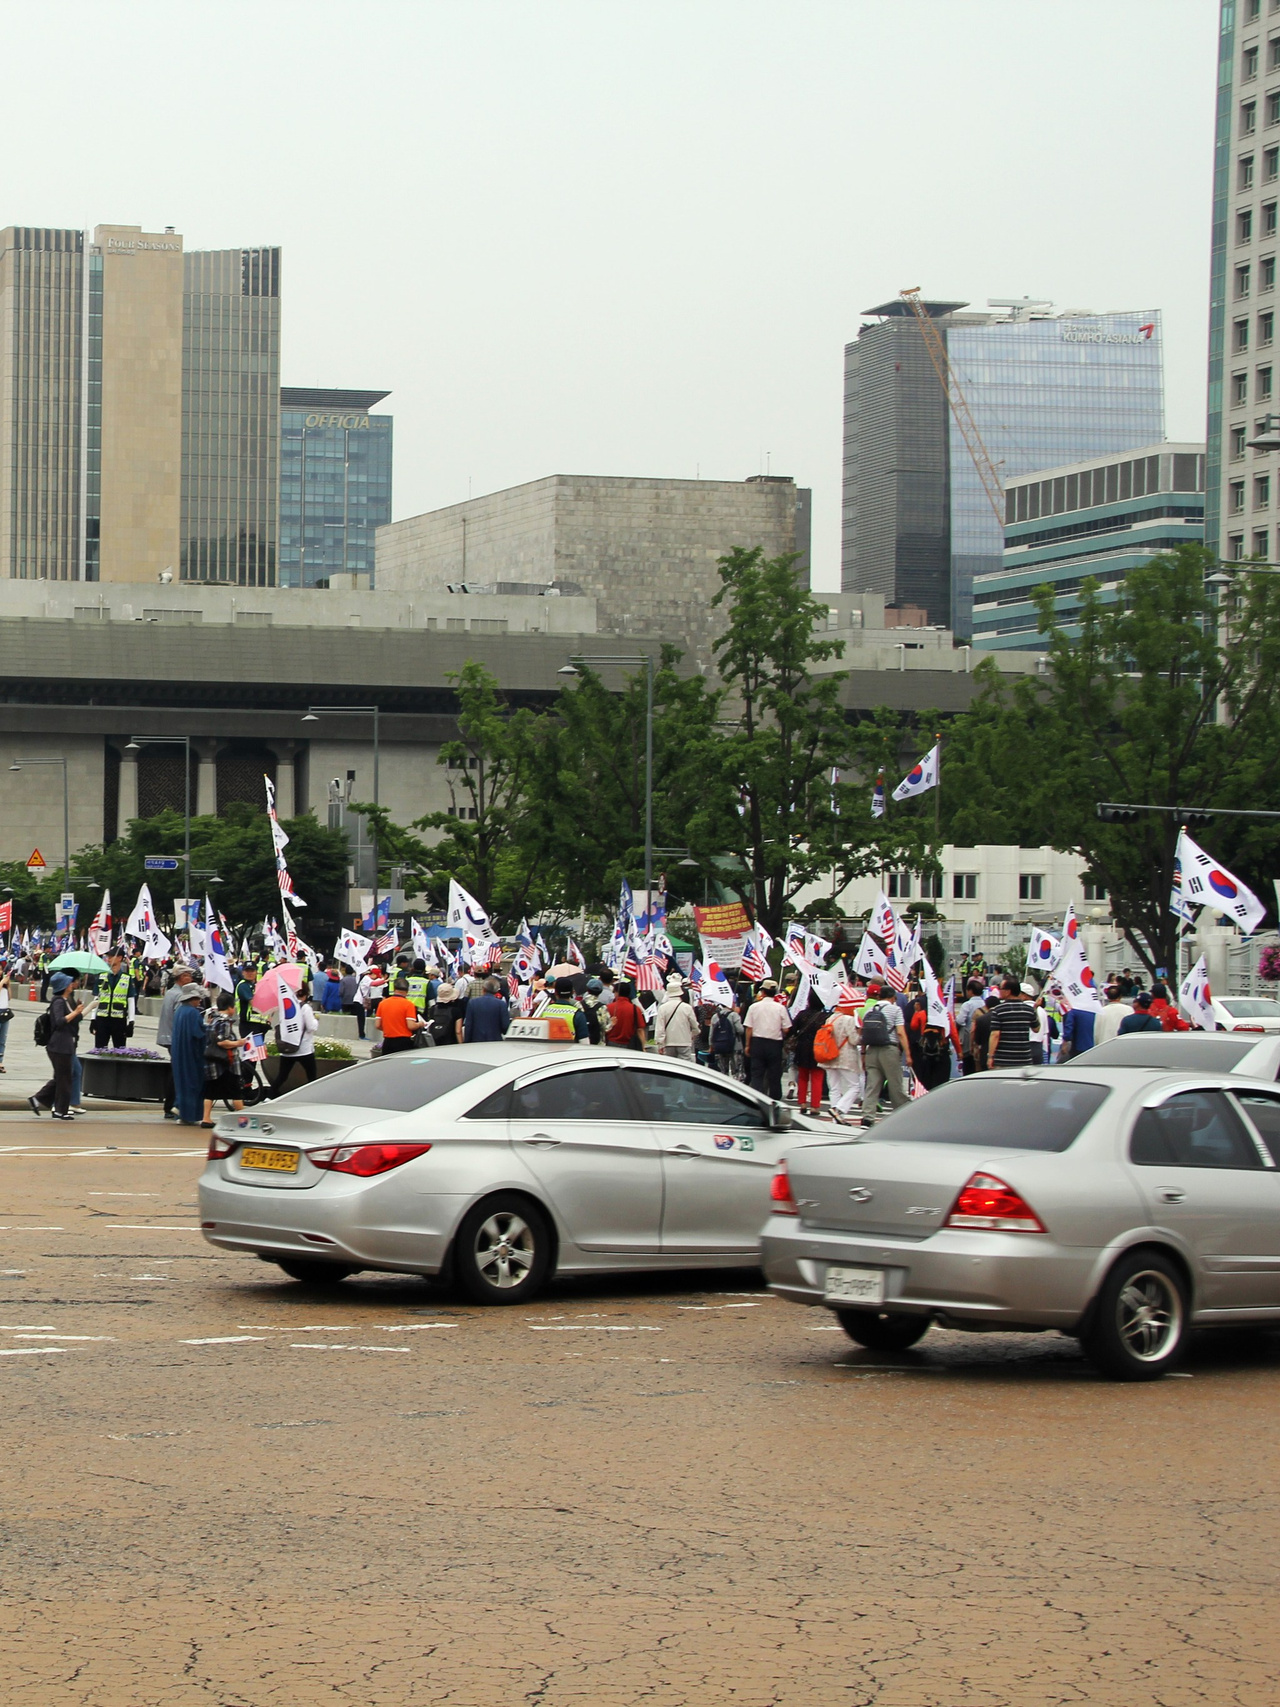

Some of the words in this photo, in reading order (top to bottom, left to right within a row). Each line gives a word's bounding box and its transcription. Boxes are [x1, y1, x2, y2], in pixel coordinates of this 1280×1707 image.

[107, 238, 135, 249] FOUR
[137, 240, 180, 251] SEASONS
[1062, 333, 1102, 344] KUMHO
[1105, 333, 1143, 345] ASIANA
[305, 414, 370, 429] OFFICIA
[511, 1025, 541, 1036] TAXI
